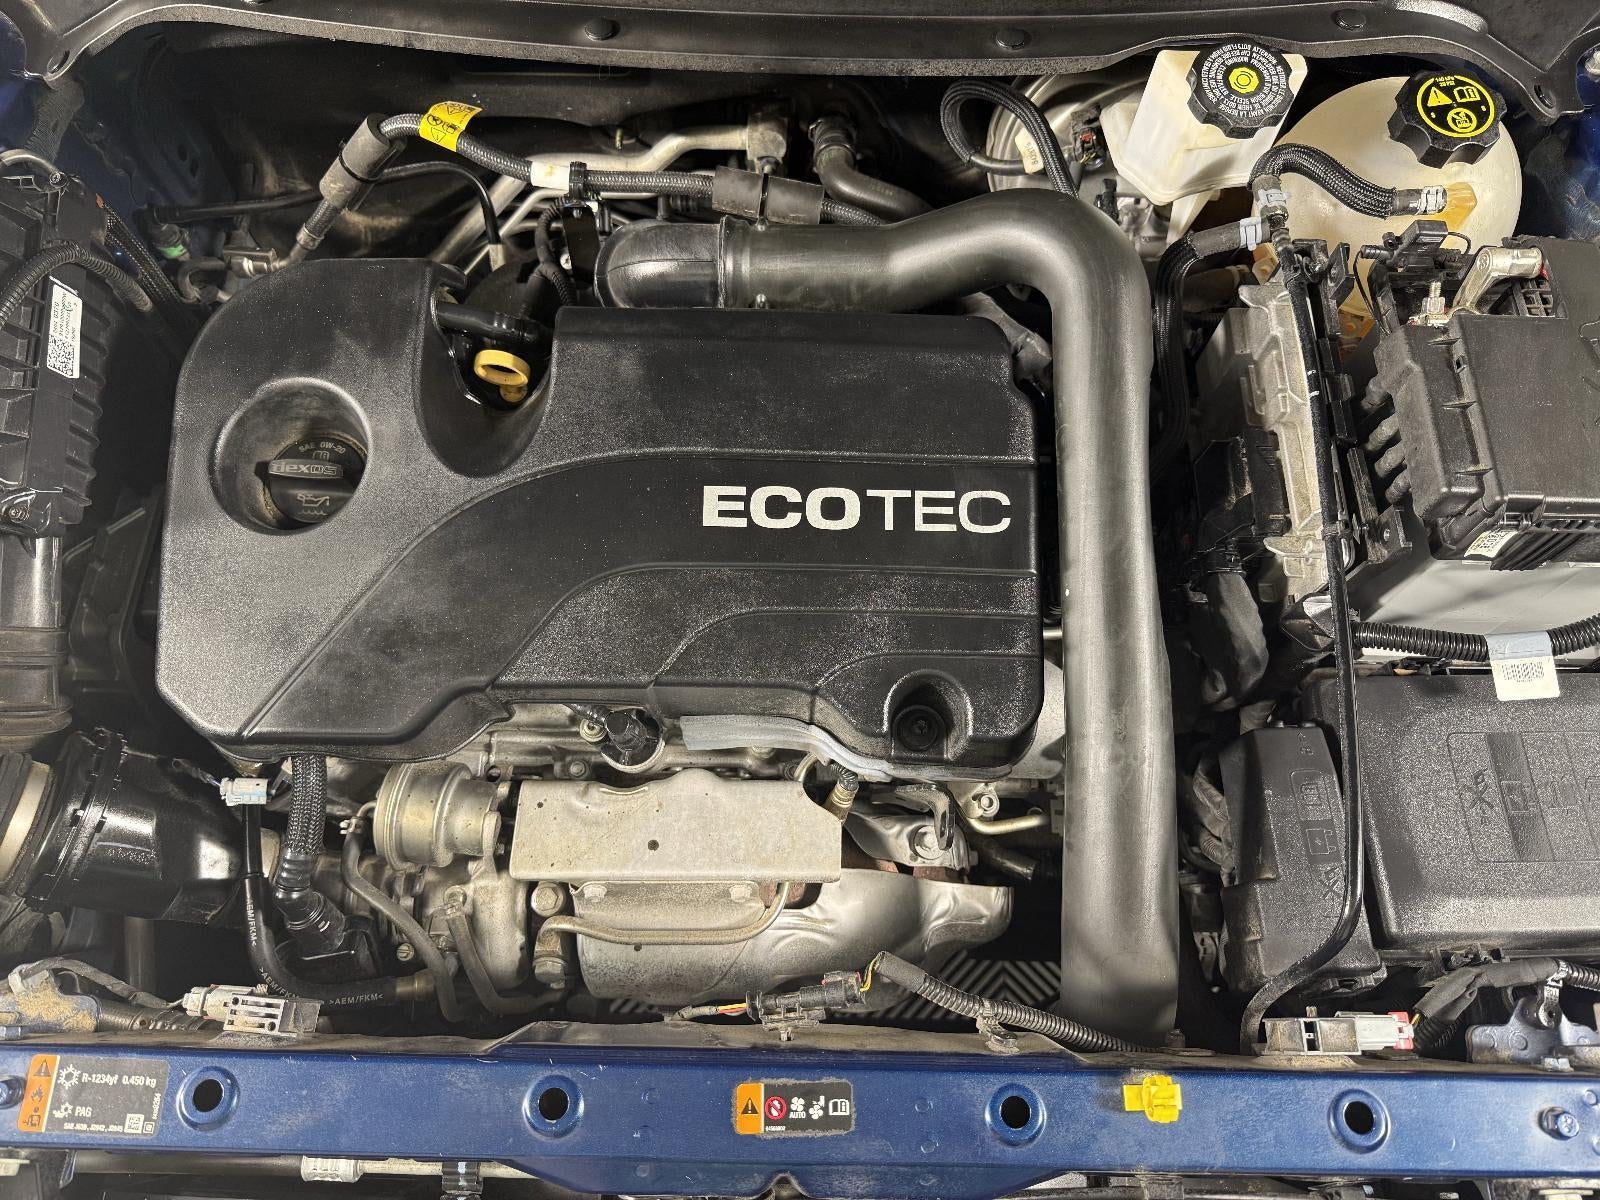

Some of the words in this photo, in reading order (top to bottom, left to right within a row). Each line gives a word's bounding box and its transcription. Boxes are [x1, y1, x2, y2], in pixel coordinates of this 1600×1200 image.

[298, 442, 316, 452] SAE
[320, 442, 346, 454] 0W-20
[702, 485, 1011, 534] ECOTEC
[82, 1072, 118, 1086] R-1234yf
[122, 1075, 144, 1086] 0.450
[146, 1077, 156, 1088] kg
[75, 1107, 92, 1118] PAG
